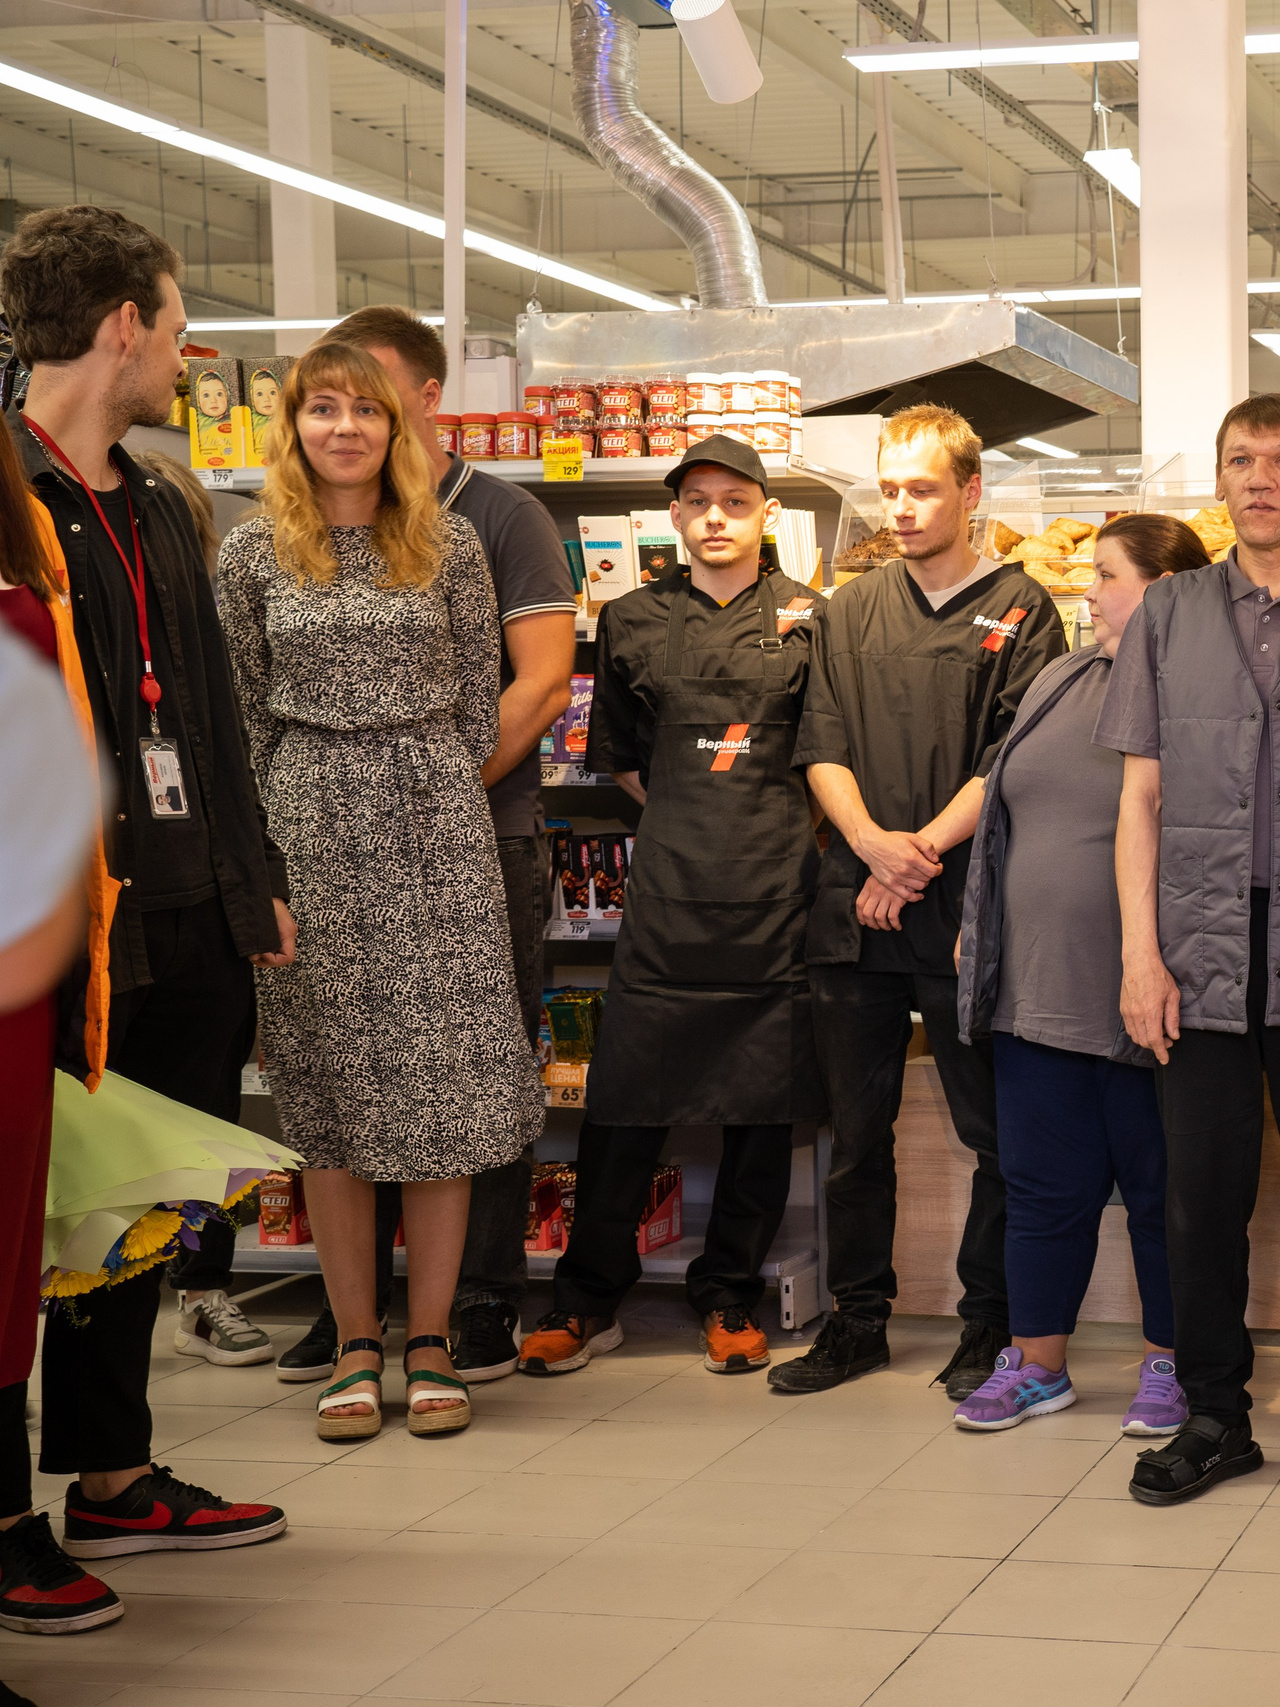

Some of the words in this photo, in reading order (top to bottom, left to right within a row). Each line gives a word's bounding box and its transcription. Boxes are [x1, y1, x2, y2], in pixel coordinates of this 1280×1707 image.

[462, 431, 491, 447] Choosy
[546, 446, 579, 455] АКЦИЯ!
[563, 466, 579, 475] 129
[213, 473, 229, 483] 179
[570, 690, 593, 708] Milk
[696, 736, 752, 752] Верный
[541, 770, 554, 780] 09
[571, 925, 586, 934] 119
[550, 1067, 581, 1075] ЛУЧШАЯ
[550, 1074, 581, 1083] ЦЕНА!
[561, 1087, 580, 1102] 65
[261, 1196, 289, 1206] СТЕП
[648, 1219, 669, 1238] СТЕП
